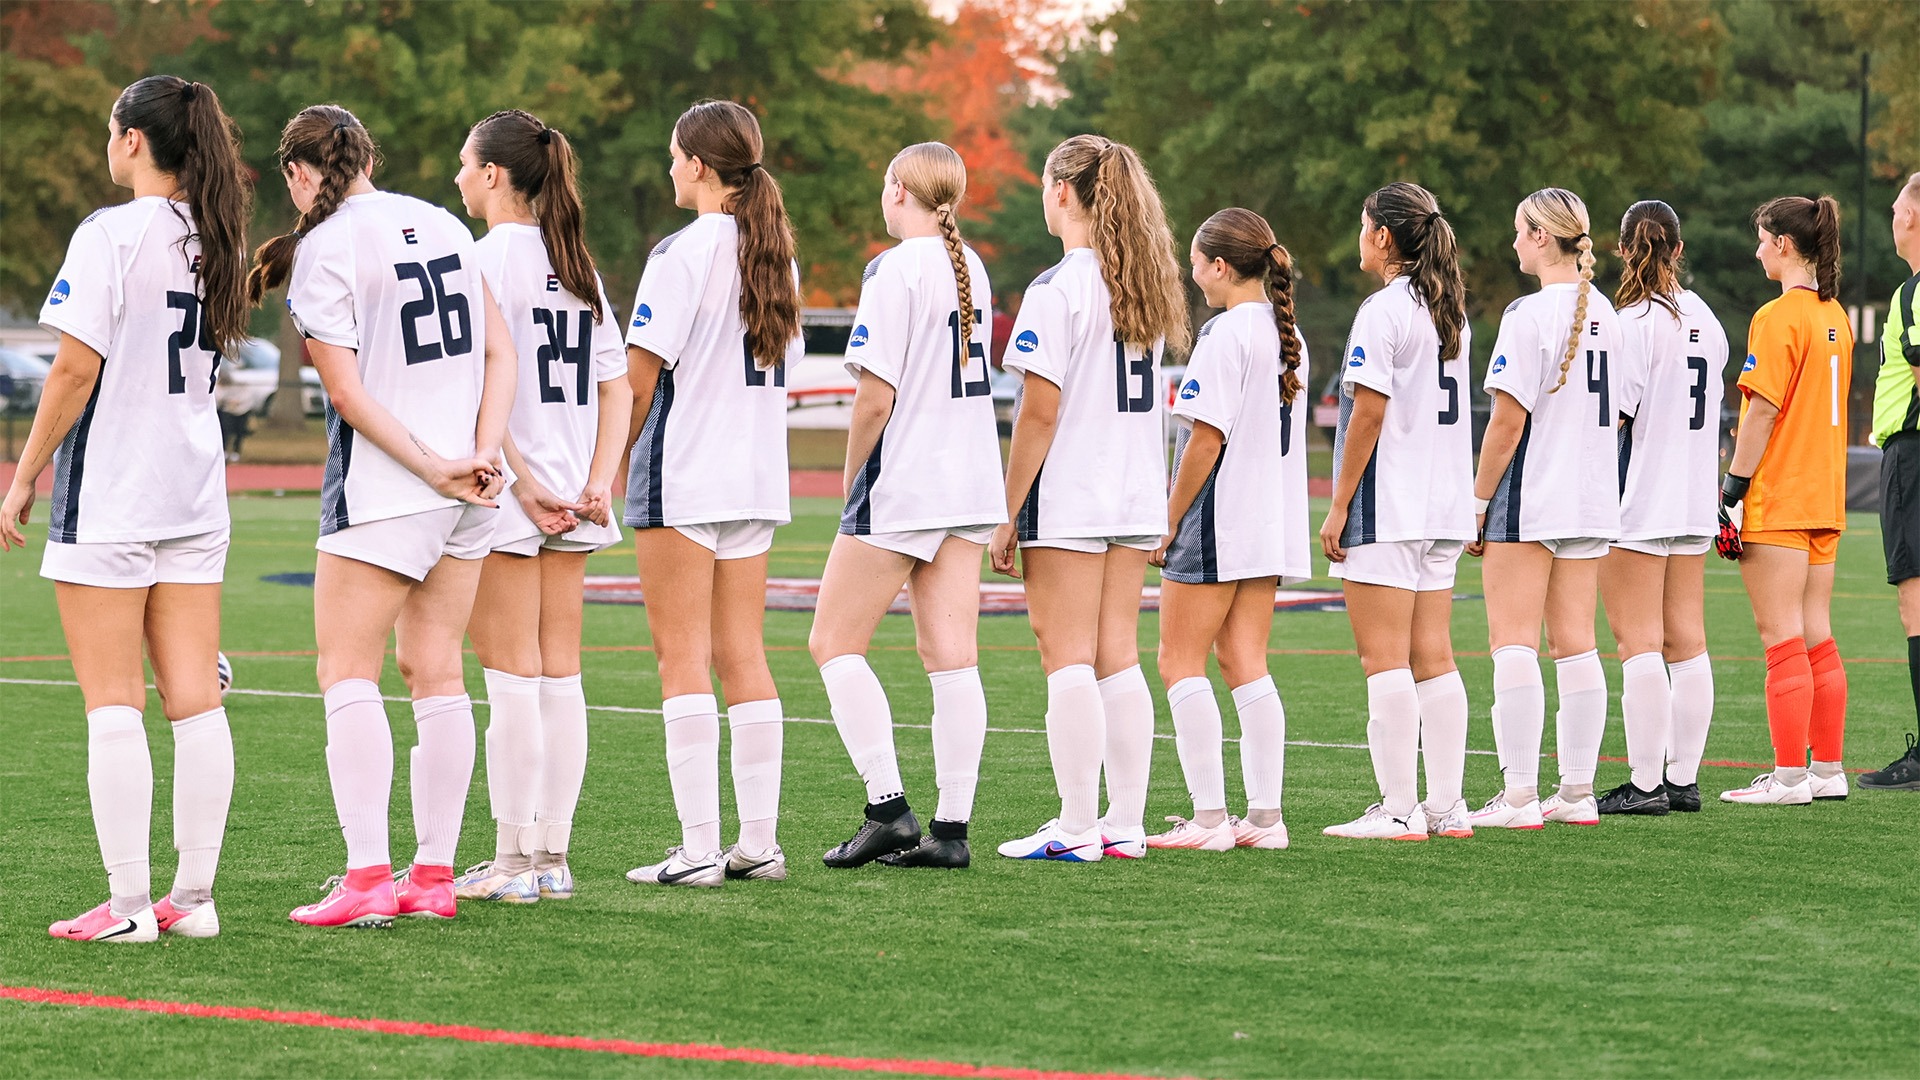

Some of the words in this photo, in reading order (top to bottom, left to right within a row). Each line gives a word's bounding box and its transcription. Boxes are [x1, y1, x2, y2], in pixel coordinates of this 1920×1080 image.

[402, 228, 418, 245] E
[394, 253, 473, 366] 26
[546, 274, 560, 292] E
[532, 307, 593, 406] 24
[948, 308, 991, 399] 15
[1016, 339, 1037, 351] NCAA
[1590, 321, 1600, 336] E
[1689, 329, 1699, 343] E
[1828, 328, 1836, 342] E
[1113, 329, 1153, 413] 13
[1438, 345, 1459, 425] 5
[1586, 350, 1611, 427] 4
[1687, 356, 1708, 430] 3
[1830, 354, 1840, 426] 1
